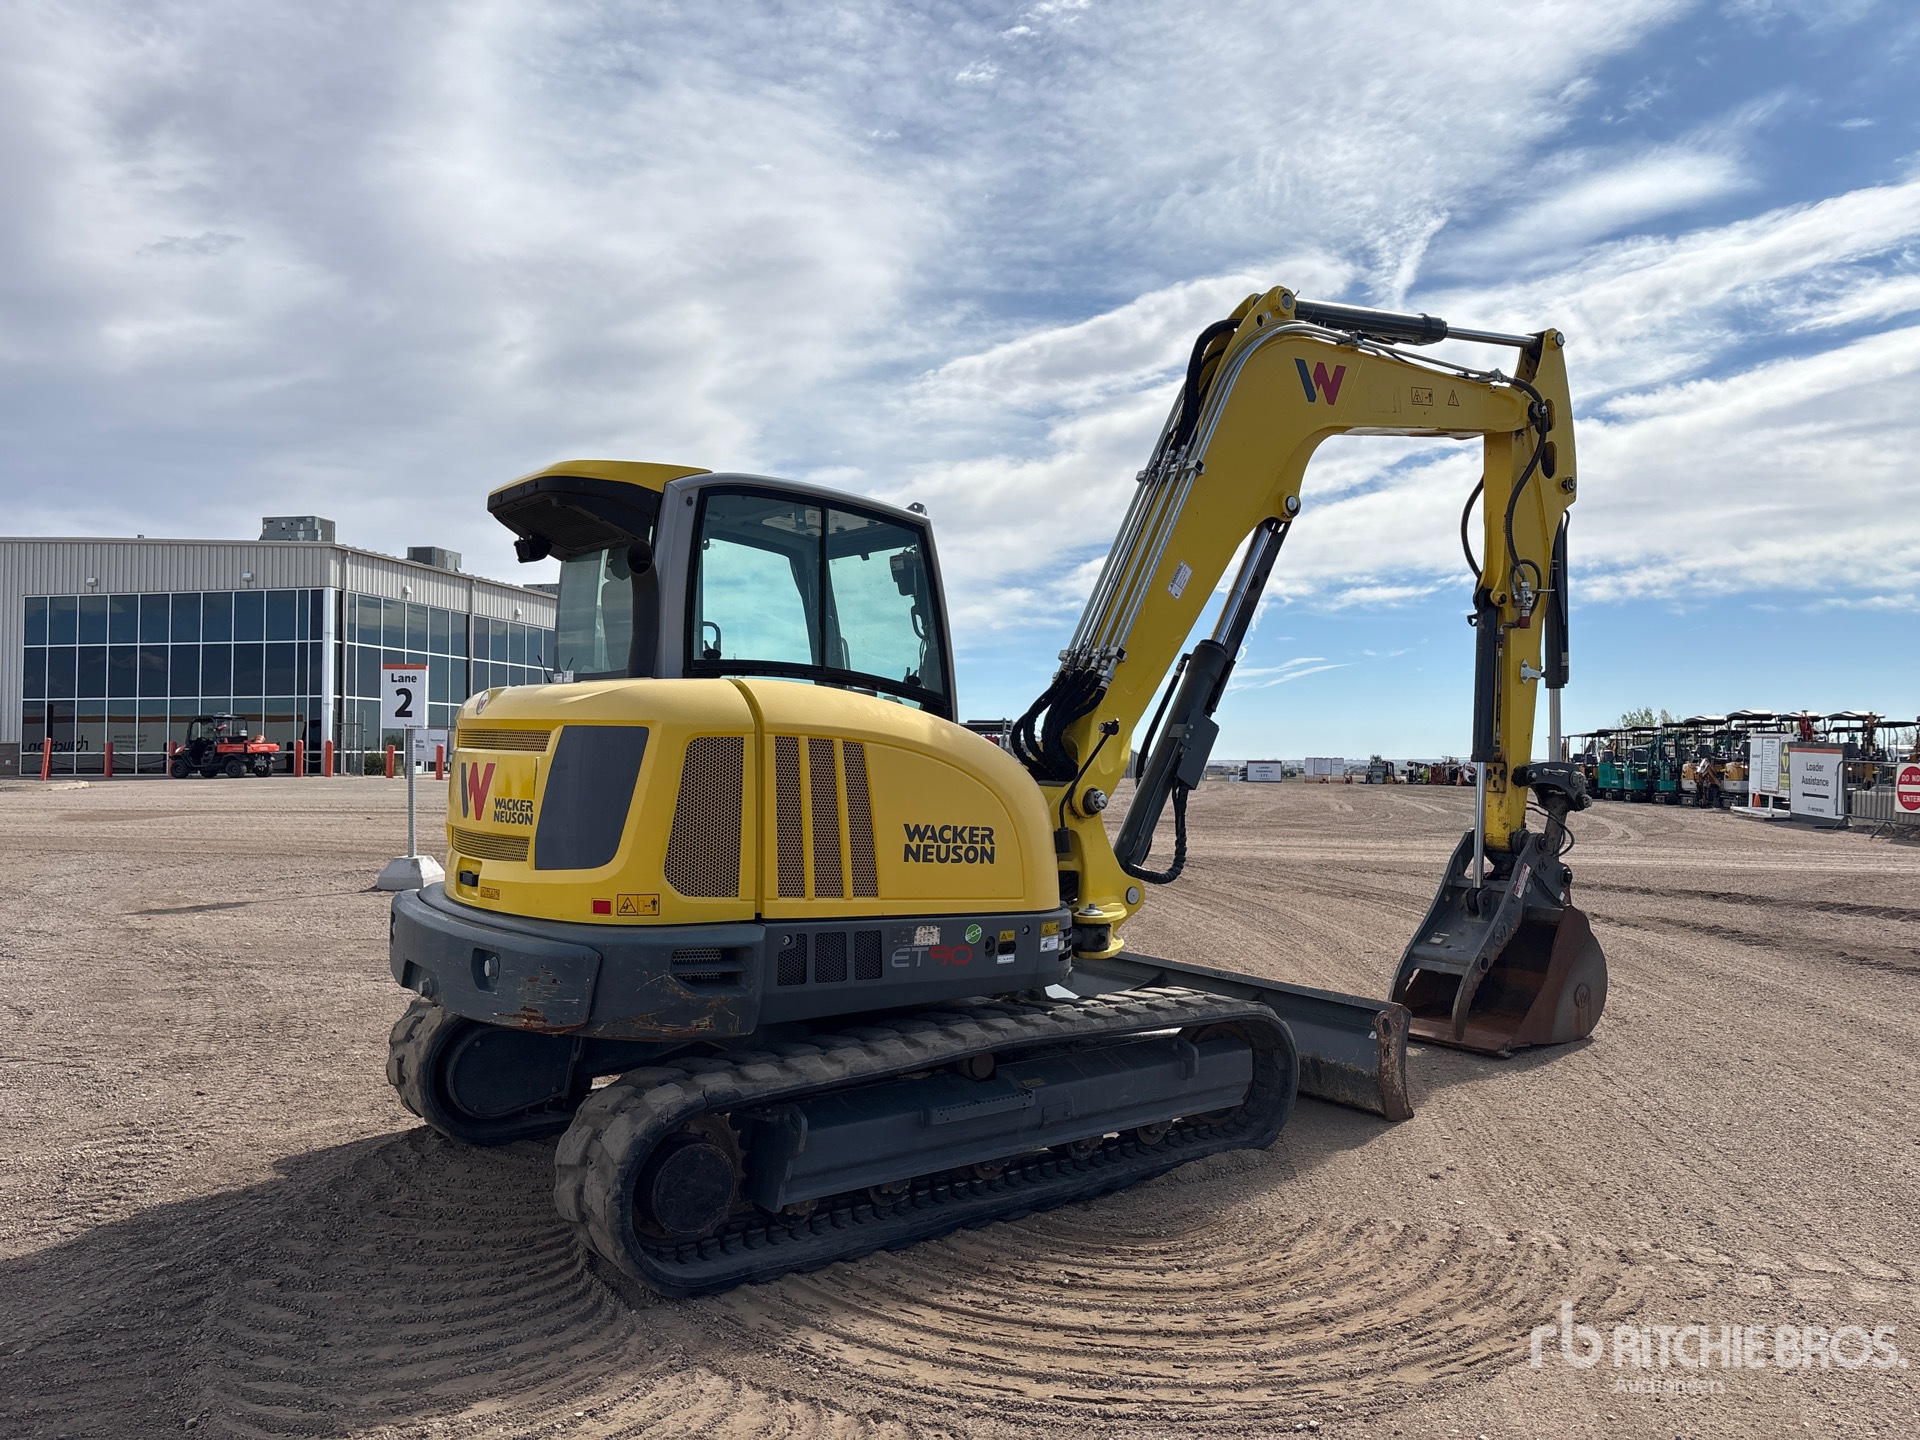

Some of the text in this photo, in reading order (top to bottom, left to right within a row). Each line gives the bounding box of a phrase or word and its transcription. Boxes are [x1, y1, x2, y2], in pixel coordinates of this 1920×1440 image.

[391, 673, 417, 683] Lane
[394, 688, 413, 718] 2
[1805, 762, 1824, 772] Loader
[1802, 775, 1829, 787] Assistance
[1901, 774, 1920, 782] DO NO
[494, 797, 534, 813] WACKER
[493, 810, 534, 826] NEUSON
[903, 823, 995, 845] WACKER
[903, 844, 995, 864] NEUSON
[891, 945, 973, 968] ET90
